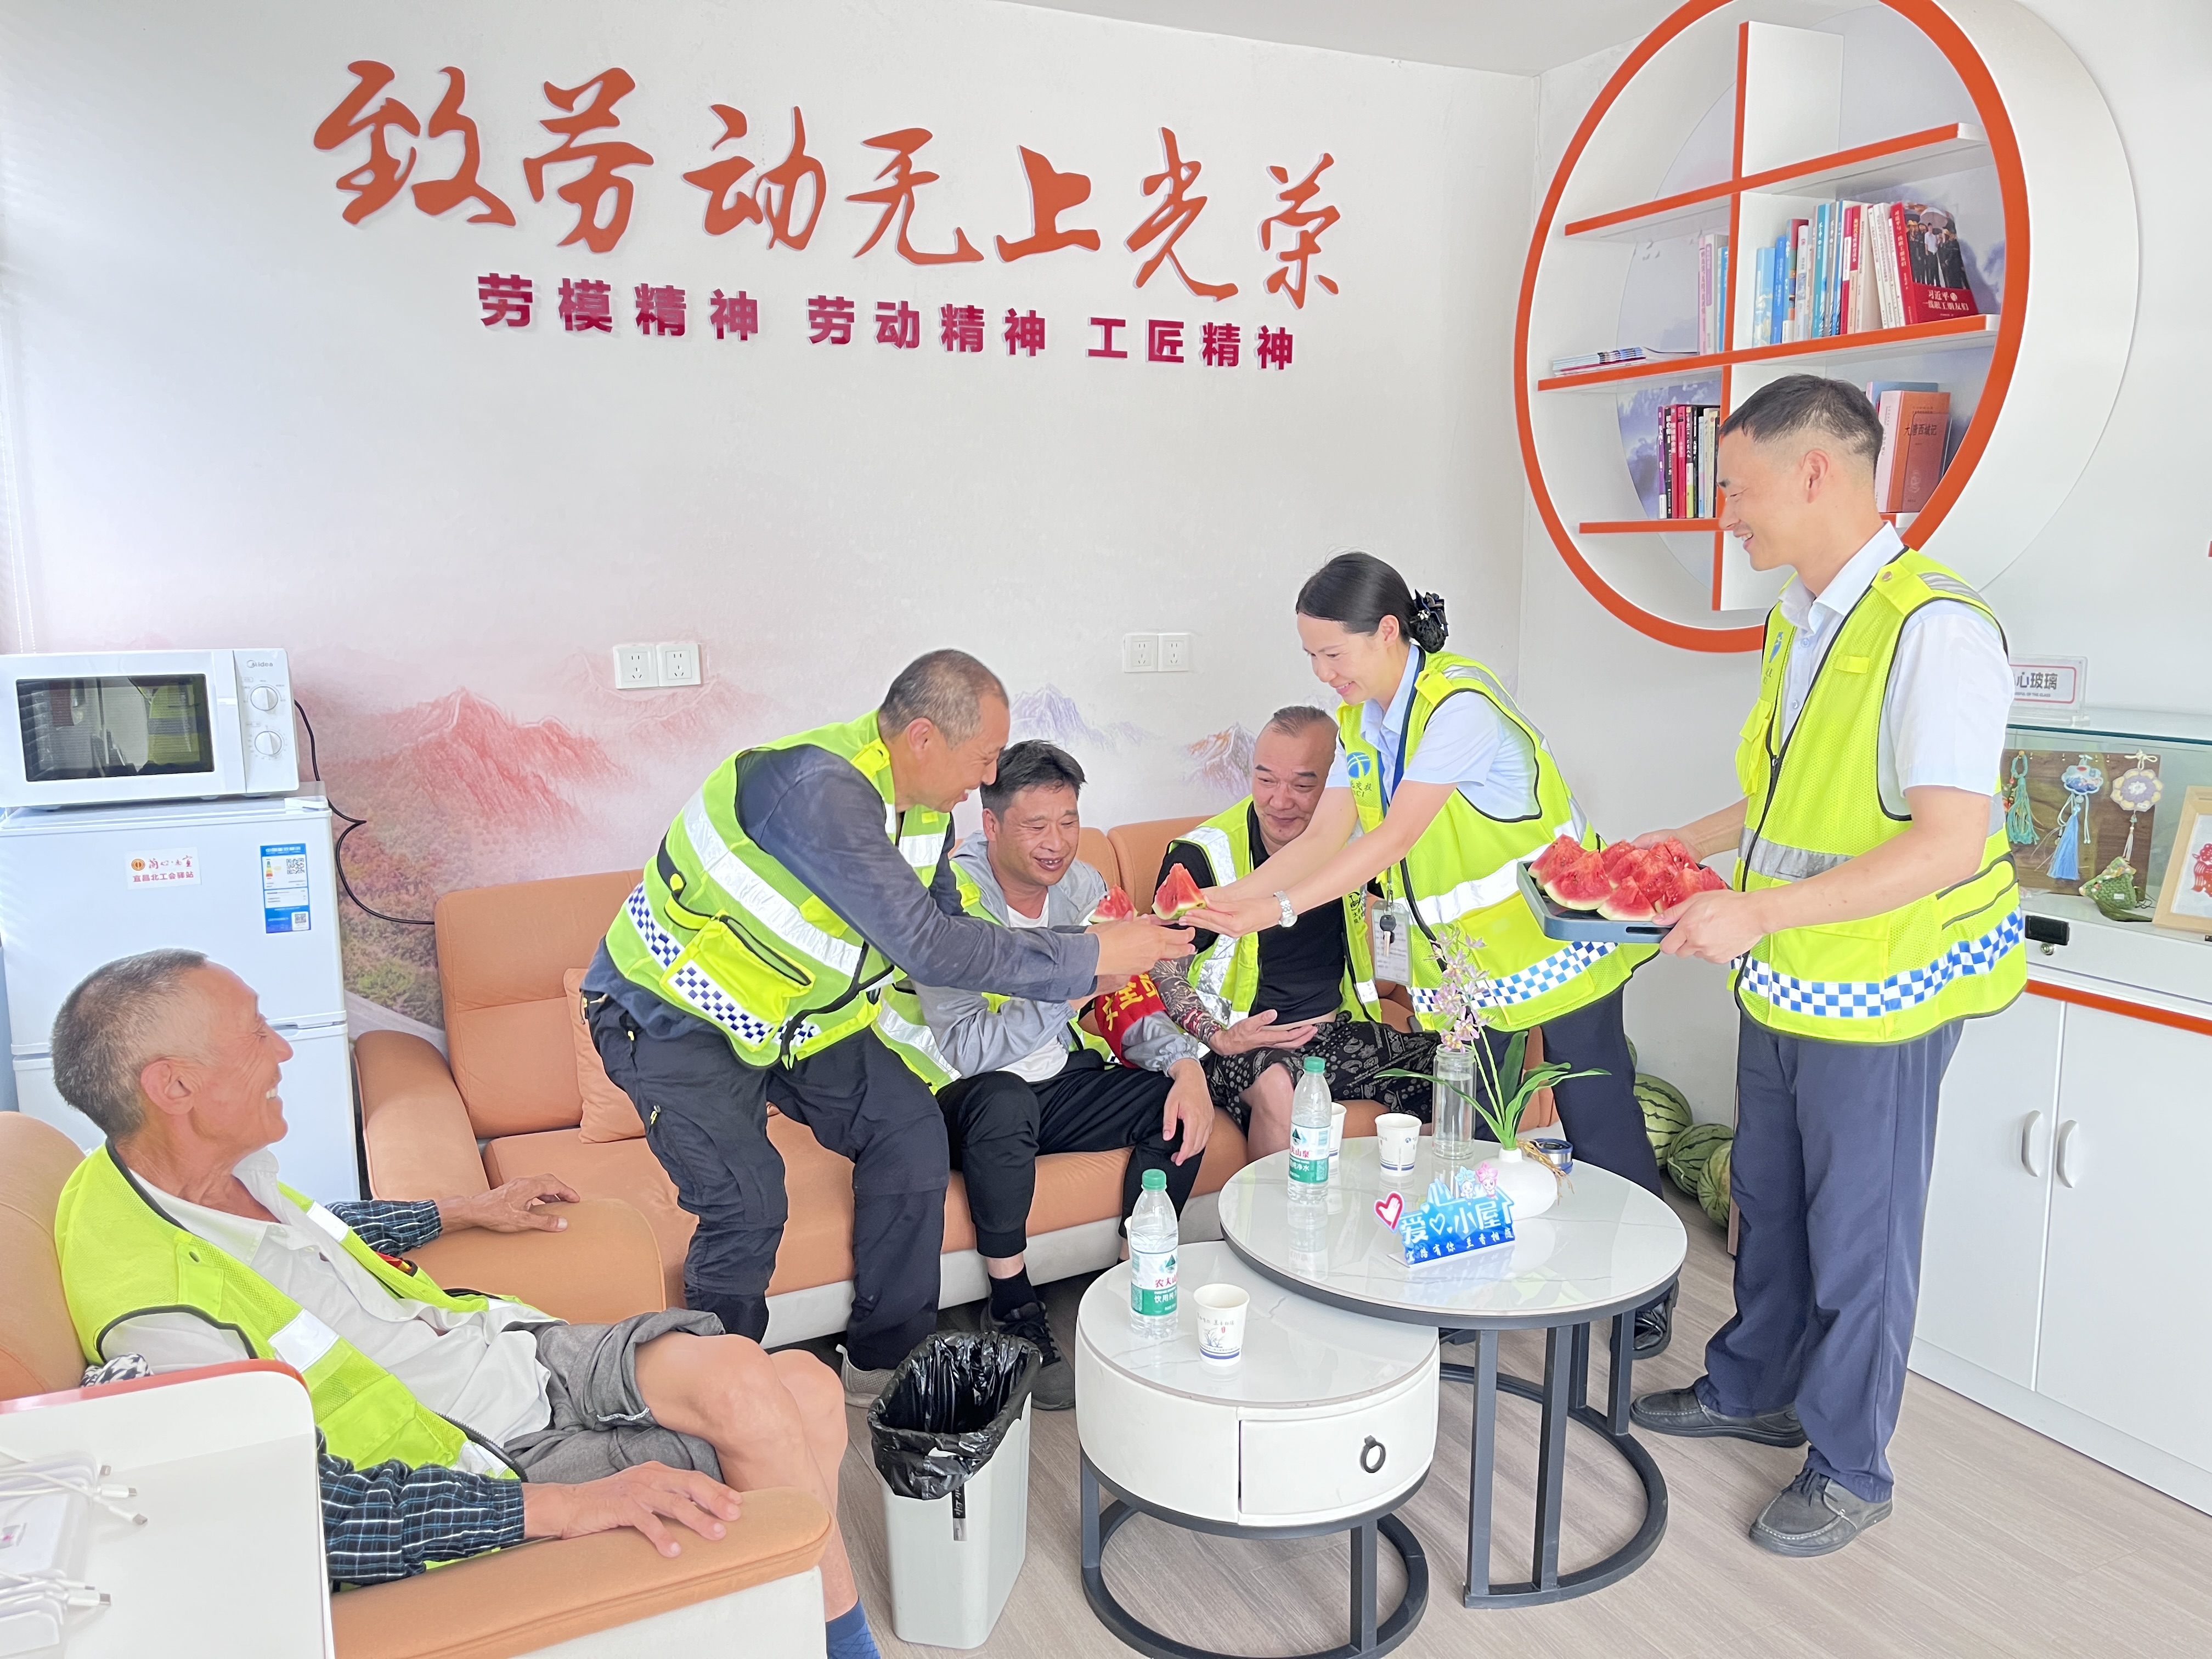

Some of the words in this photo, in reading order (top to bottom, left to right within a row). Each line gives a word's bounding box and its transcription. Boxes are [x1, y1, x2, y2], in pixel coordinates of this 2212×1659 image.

[315, 61, 1340, 308] 致劳动无上光荣
[478, 274, 758, 341] 劳模精神
[809, 296, 1045, 356] 劳动精神
[1088, 317, 1293, 370] 工匠精神
[1903, 423, 1937, 436] 大唐西域记
[247, 659, 273, 668] Midea
[2015, 672, 2058, 690] 心玻璃
[133, 871, 194, 882] 宜昌北工会驿站
[1291, 1146, 1309, 1158] 夫山泉
[1155, 1274, 1177, 1288] 农夫山
[1154, 1291, 1176, 1303] 饮用纯
